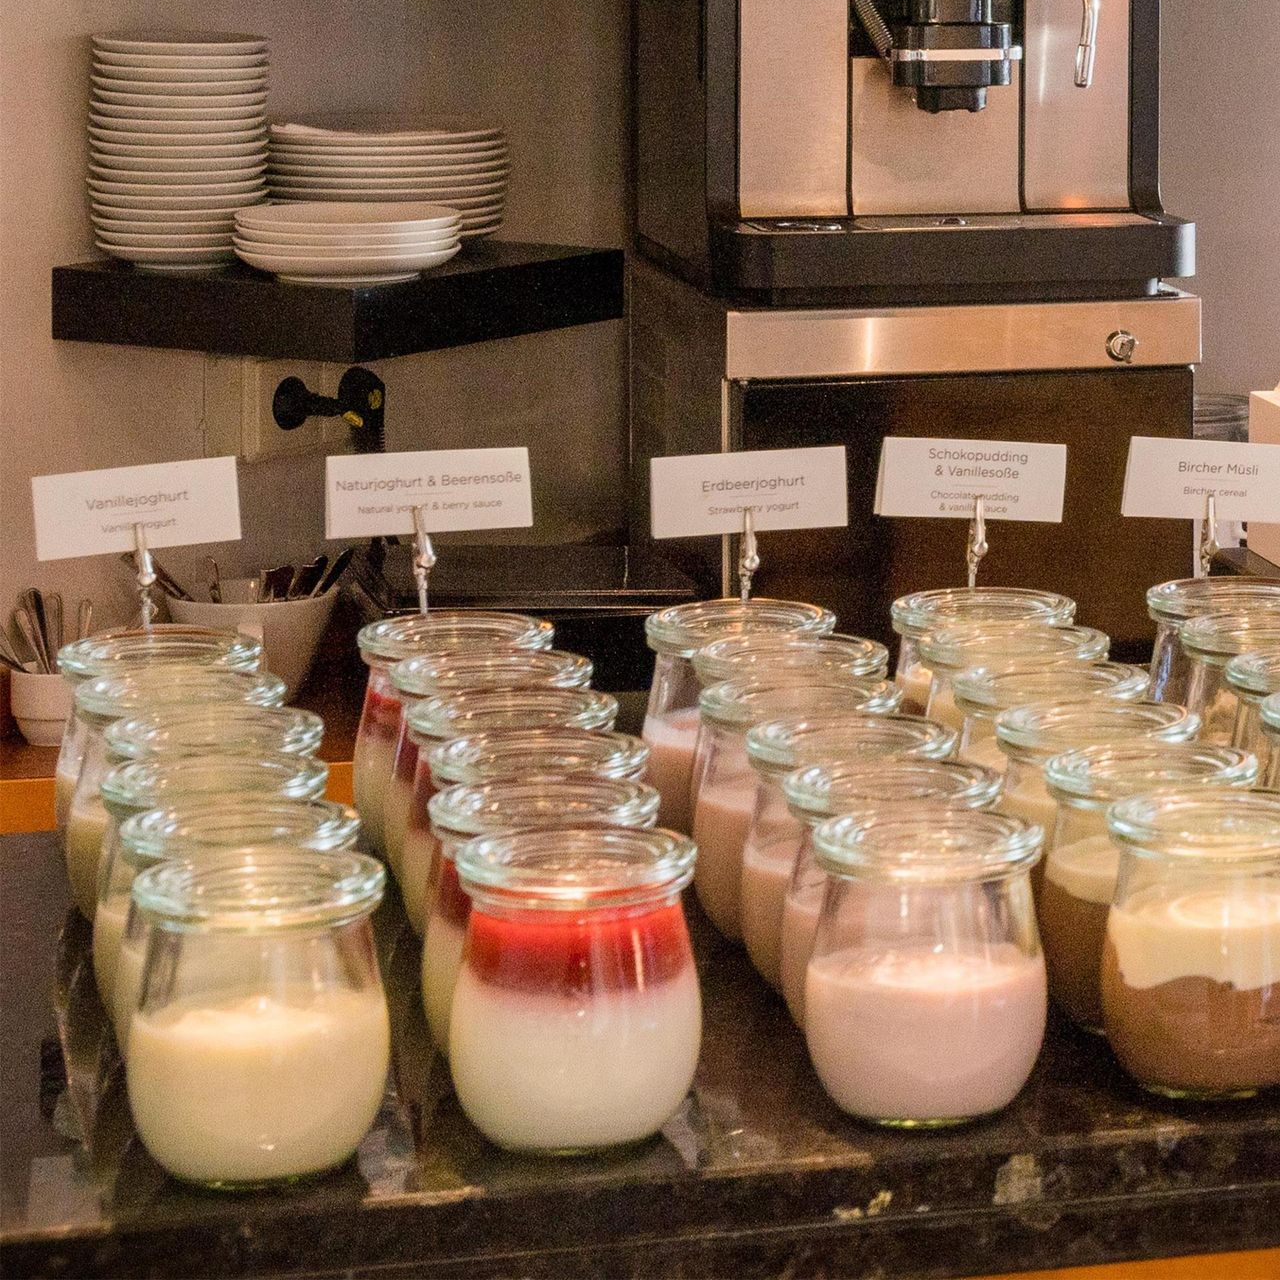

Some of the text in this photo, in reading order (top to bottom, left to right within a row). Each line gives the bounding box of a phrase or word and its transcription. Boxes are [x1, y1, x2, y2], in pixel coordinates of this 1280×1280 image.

[928, 447, 1029, 465] Schokopudding
[934, 465, 1020, 479] & Vanillesoße
[1178, 461, 1259, 476] Bircher Müsli
[335, 471, 522, 492] Naturjoghurt & Beerensoße
[702, 475, 806, 493] Erdbeerjoghurt
[1183, 486, 1248, 498] Bircher cereal
[85, 490, 189, 511] Vanillejoghurt
[358, 503, 393, 515] Natural
[472, 499, 503, 509] sauce
[766, 501, 800, 513] yogurt
[939, 503, 946, 512] &
[981, 505, 1008, 514] auce
